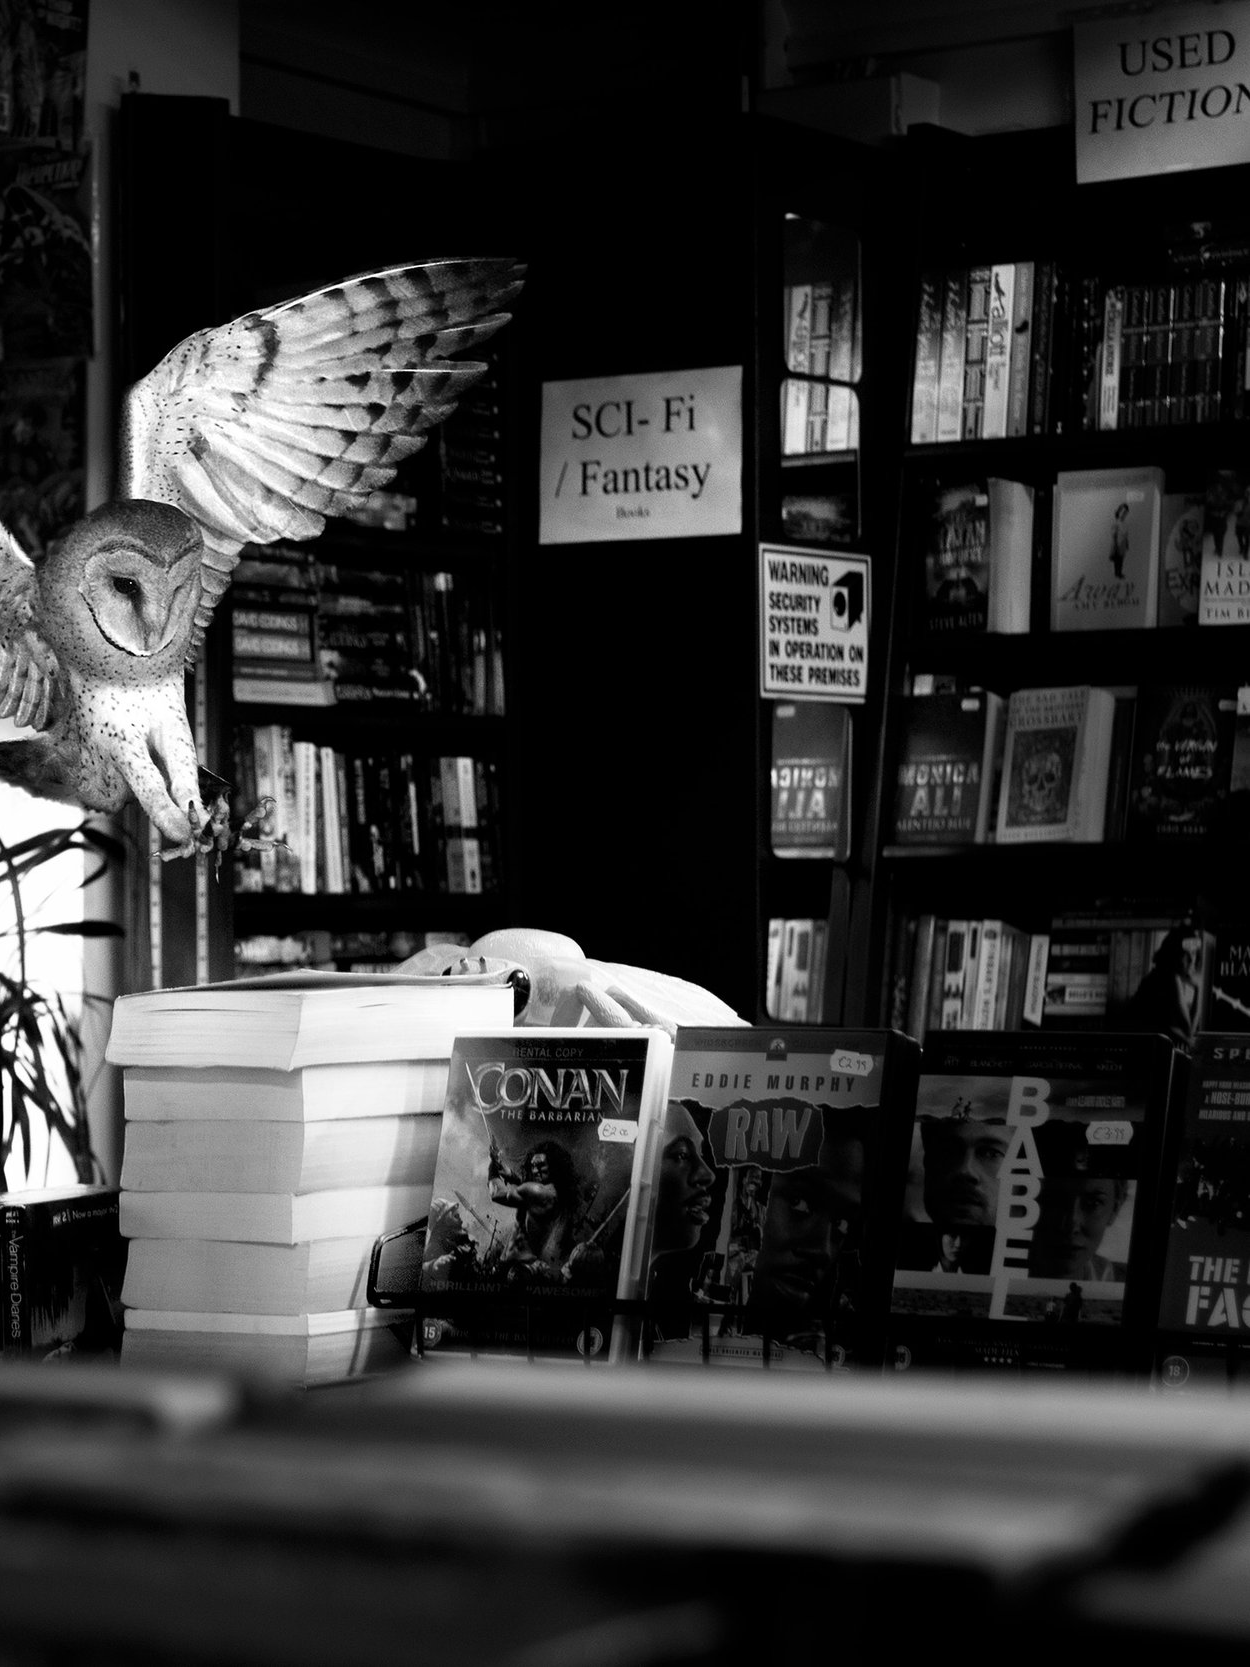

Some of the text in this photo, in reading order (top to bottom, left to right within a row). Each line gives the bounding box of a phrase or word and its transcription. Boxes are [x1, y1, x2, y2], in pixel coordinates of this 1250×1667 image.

[1118, 29, 1236, 76] USED
[571, 394, 695, 441] SCI- Fi
[581, 460, 711, 499] Fantasy
[769, 560, 829, 587] WARNING
[769, 591, 821, 613] SECURITY
[769, 615, 819, 636] SYSTEMS
[769, 640, 864, 662] IN OPERATION ON
[769, 663, 860, 686] THESE PREMISES
[899, 761, 980, 786] MONICA
[909, 785, 964, 817] ALI
[513, 1047, 585, 1059] RENTAL COPY
[472, 1062, 630, 1115] CONAN
[692, 1072, 855, 1092] EDDIE MURPHY
[500, 1109, 605, 1124] THE BARBARIAN
[724, 1106, 813, 1161] RAW
[988, 1075, 1052, 1323] BABEL
[71, 1209, 86, 1221] Now
[1189, 1255, 1240, 1285] THE
[8, 1235, 25, 1339] Vampire Diaries
[424, 1326, 436, 1339] 15
[1169, 1364, 1181, 1377] 18
